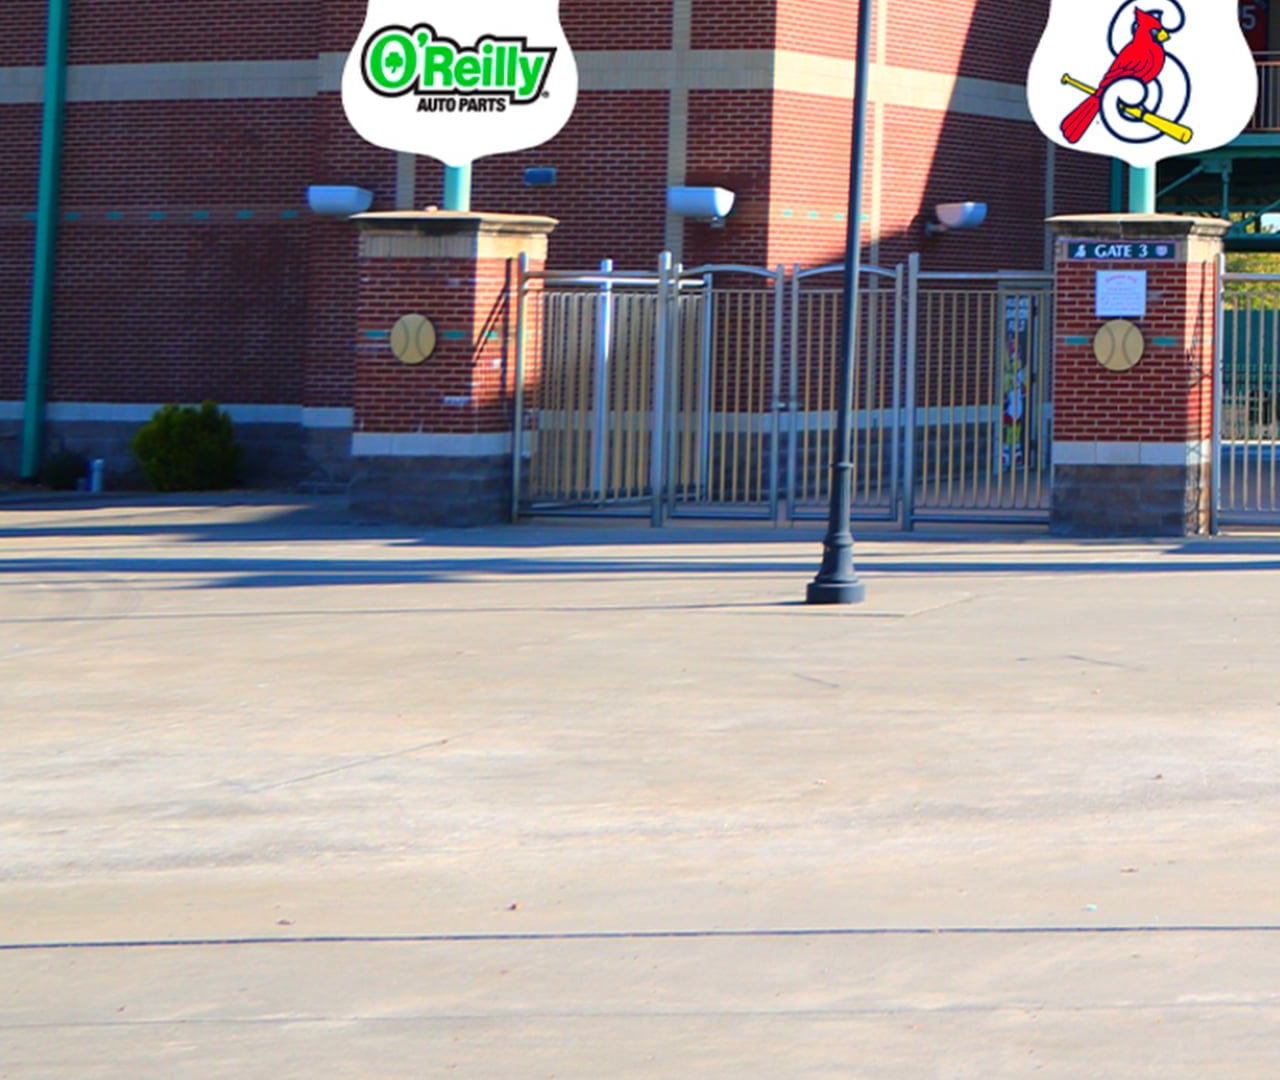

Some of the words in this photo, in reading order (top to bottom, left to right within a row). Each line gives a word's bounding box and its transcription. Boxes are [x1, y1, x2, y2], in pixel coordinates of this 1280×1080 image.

[369, 31, 545, 97] O'Reilly
[417, 98, 457, 112] AUTO
[459, 98, 506, 112] PARTS
[1094, 244, 1133, 258] GATE
[1138, 244, 1148, 258] 3
